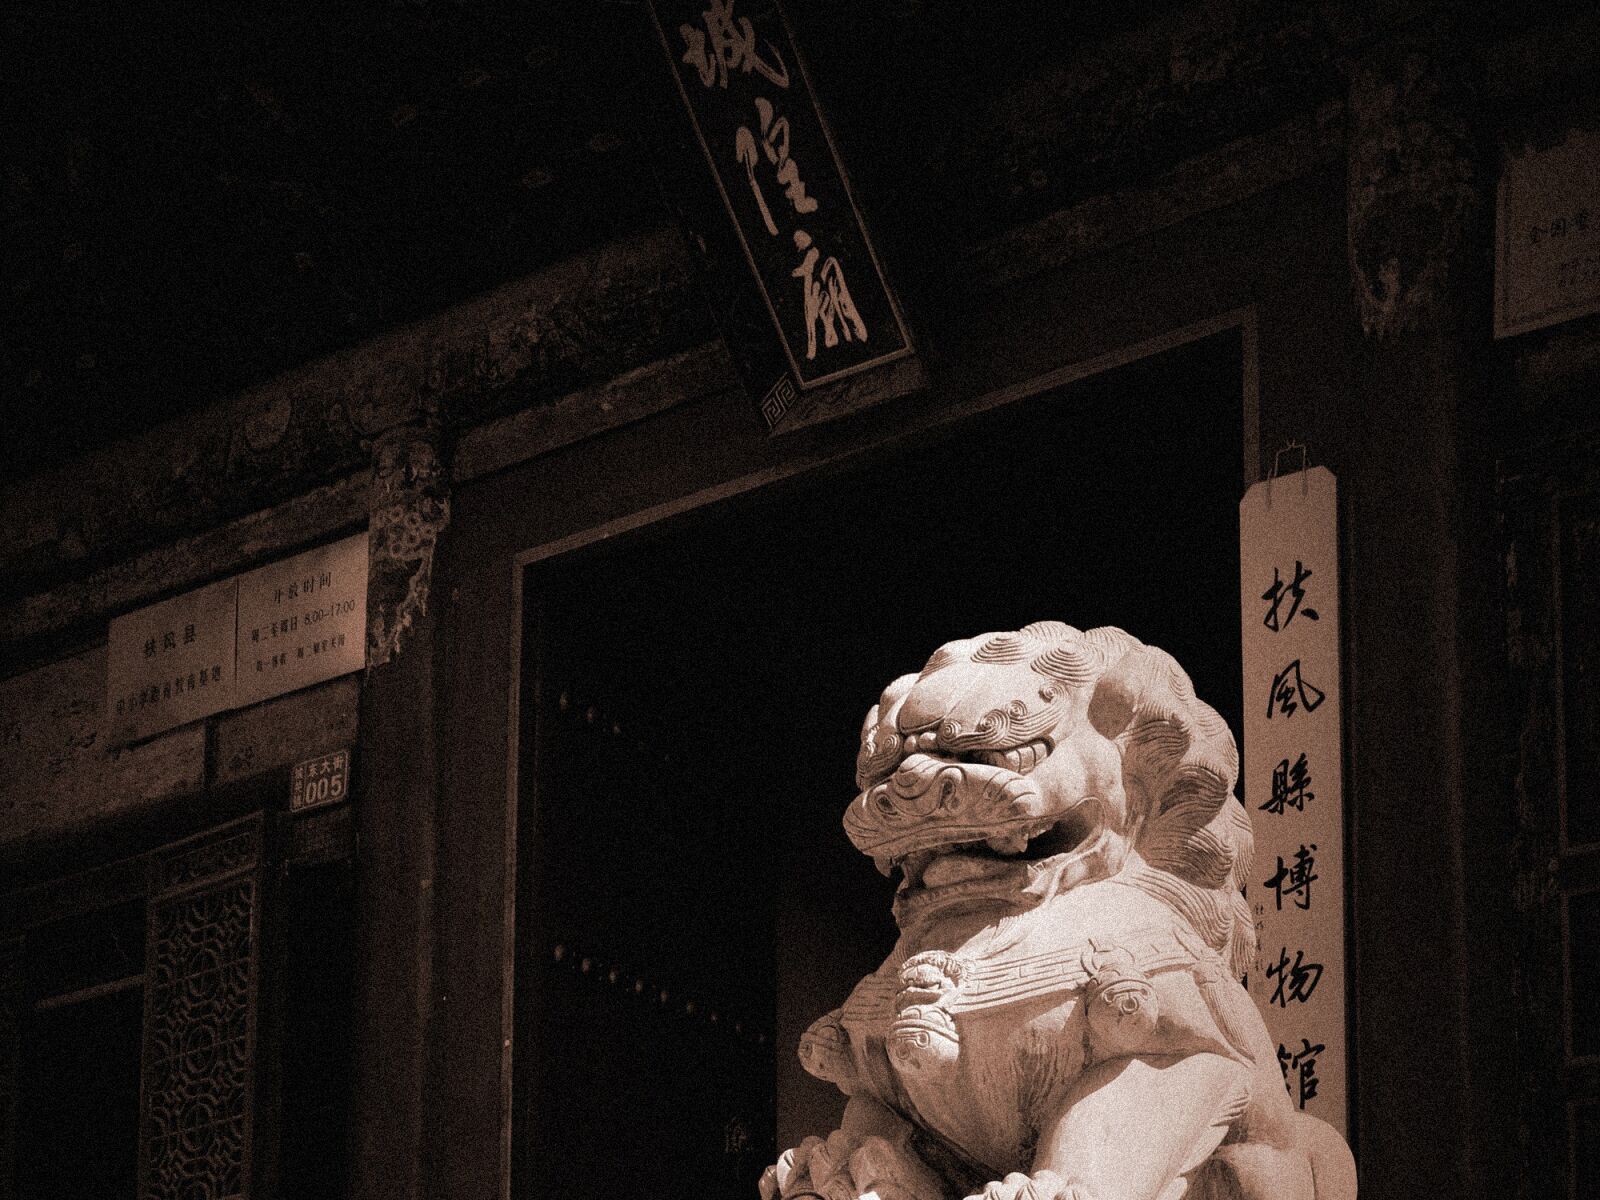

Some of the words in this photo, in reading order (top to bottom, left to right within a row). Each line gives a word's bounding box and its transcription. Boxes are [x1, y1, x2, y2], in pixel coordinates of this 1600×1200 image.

[144, 624, 196, 658] 扶风县
[306, 774, 342, 803] 005
[1258, 561, 1325, 1110] 扶風縣博物館
